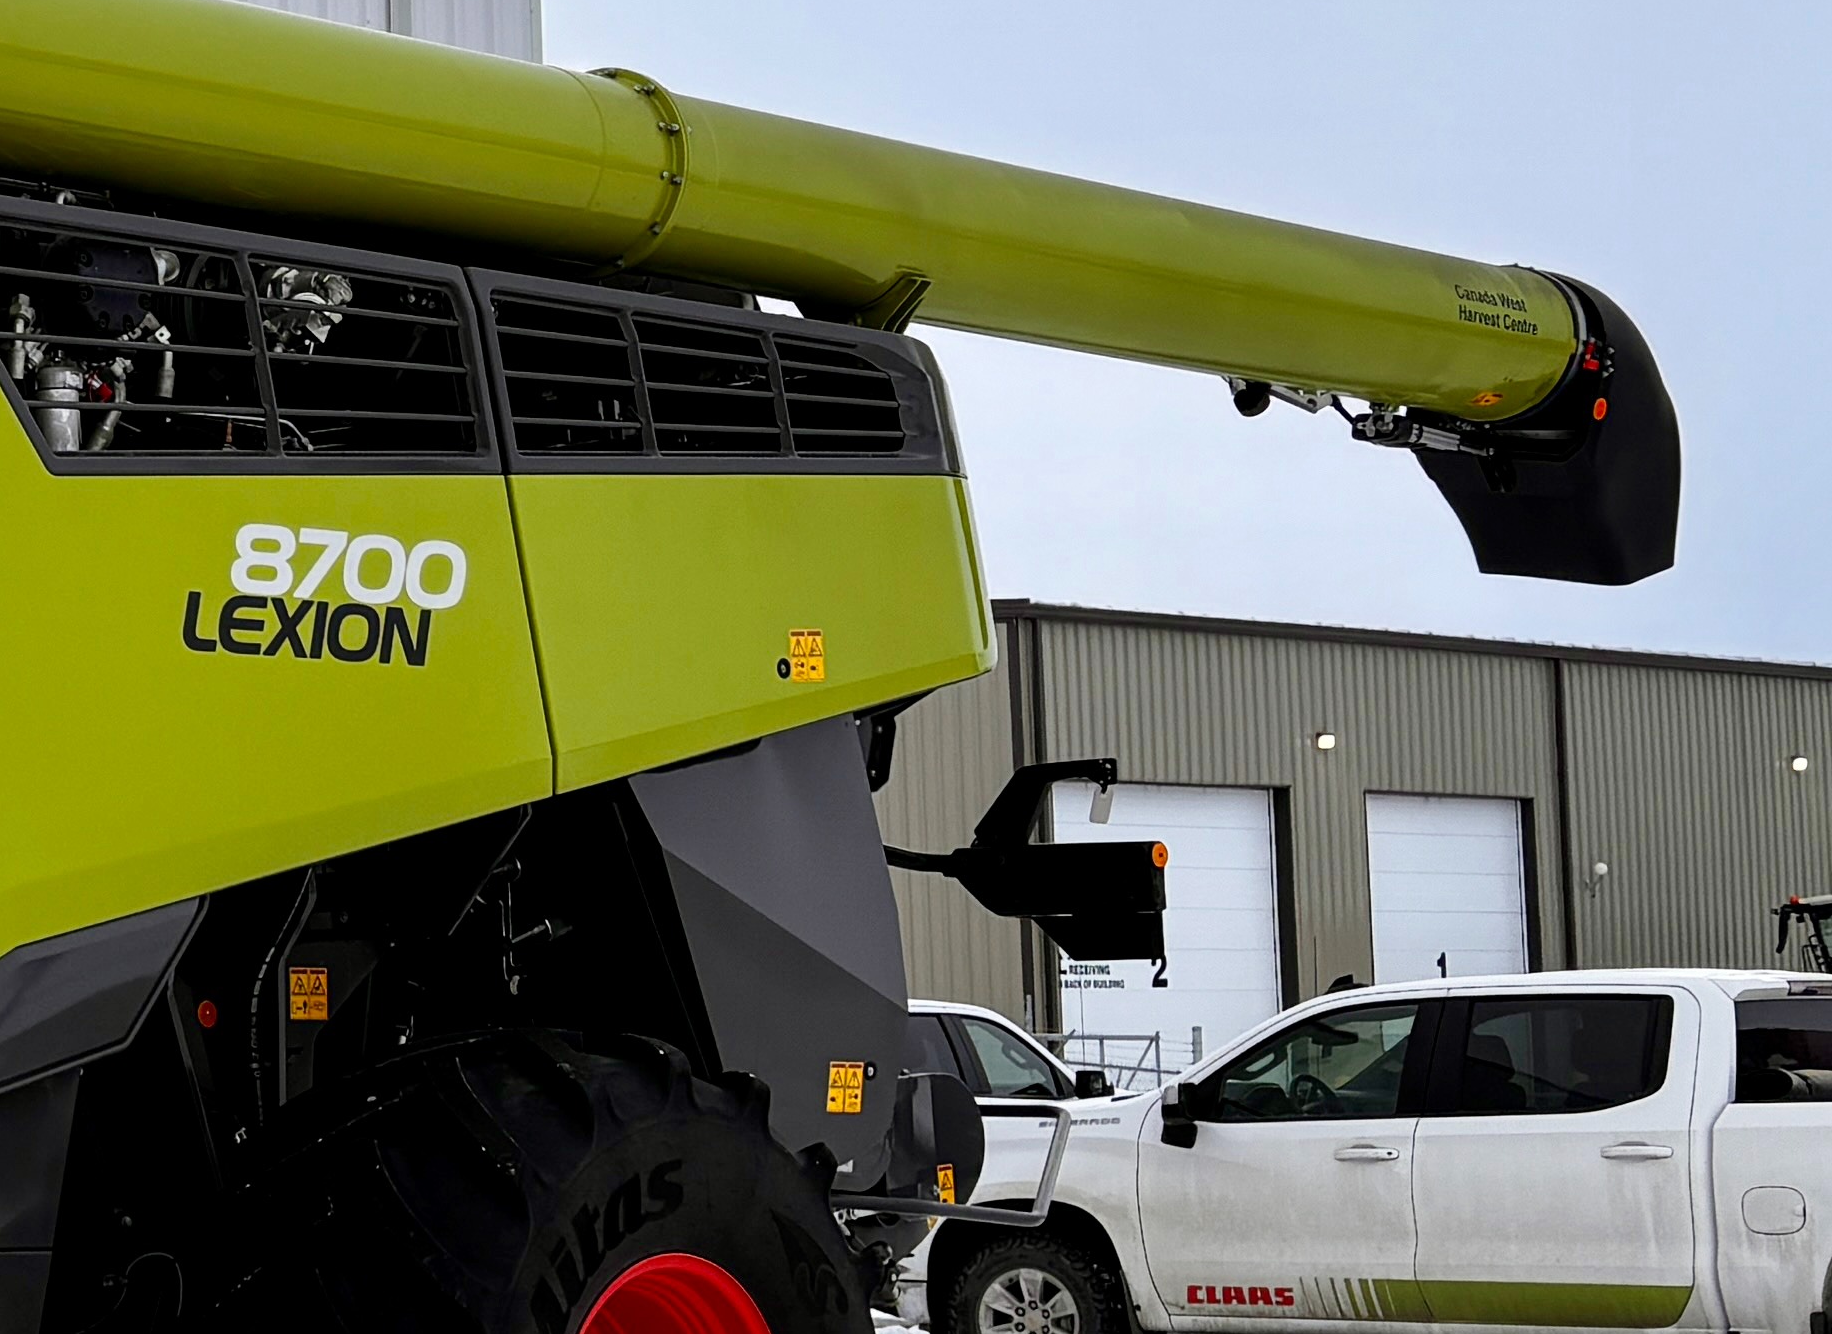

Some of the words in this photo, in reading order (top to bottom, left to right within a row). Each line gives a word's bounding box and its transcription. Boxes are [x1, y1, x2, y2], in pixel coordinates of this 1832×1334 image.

[1455, 284, 1498, 307] Canada
[1497, 293, 1527, 313] West
[1459, 304, 1501, 329] Harvest
[1503, 314, 1539, 335] Centre
[230, 523, 467, 610] 8700
[182, 591, 432, 667] LEXION
[1151, 954, 1169, 988] 2
[1436, 951, 1447, 979] 1
[1186, 1284, 1295, 1307] CLAAS
